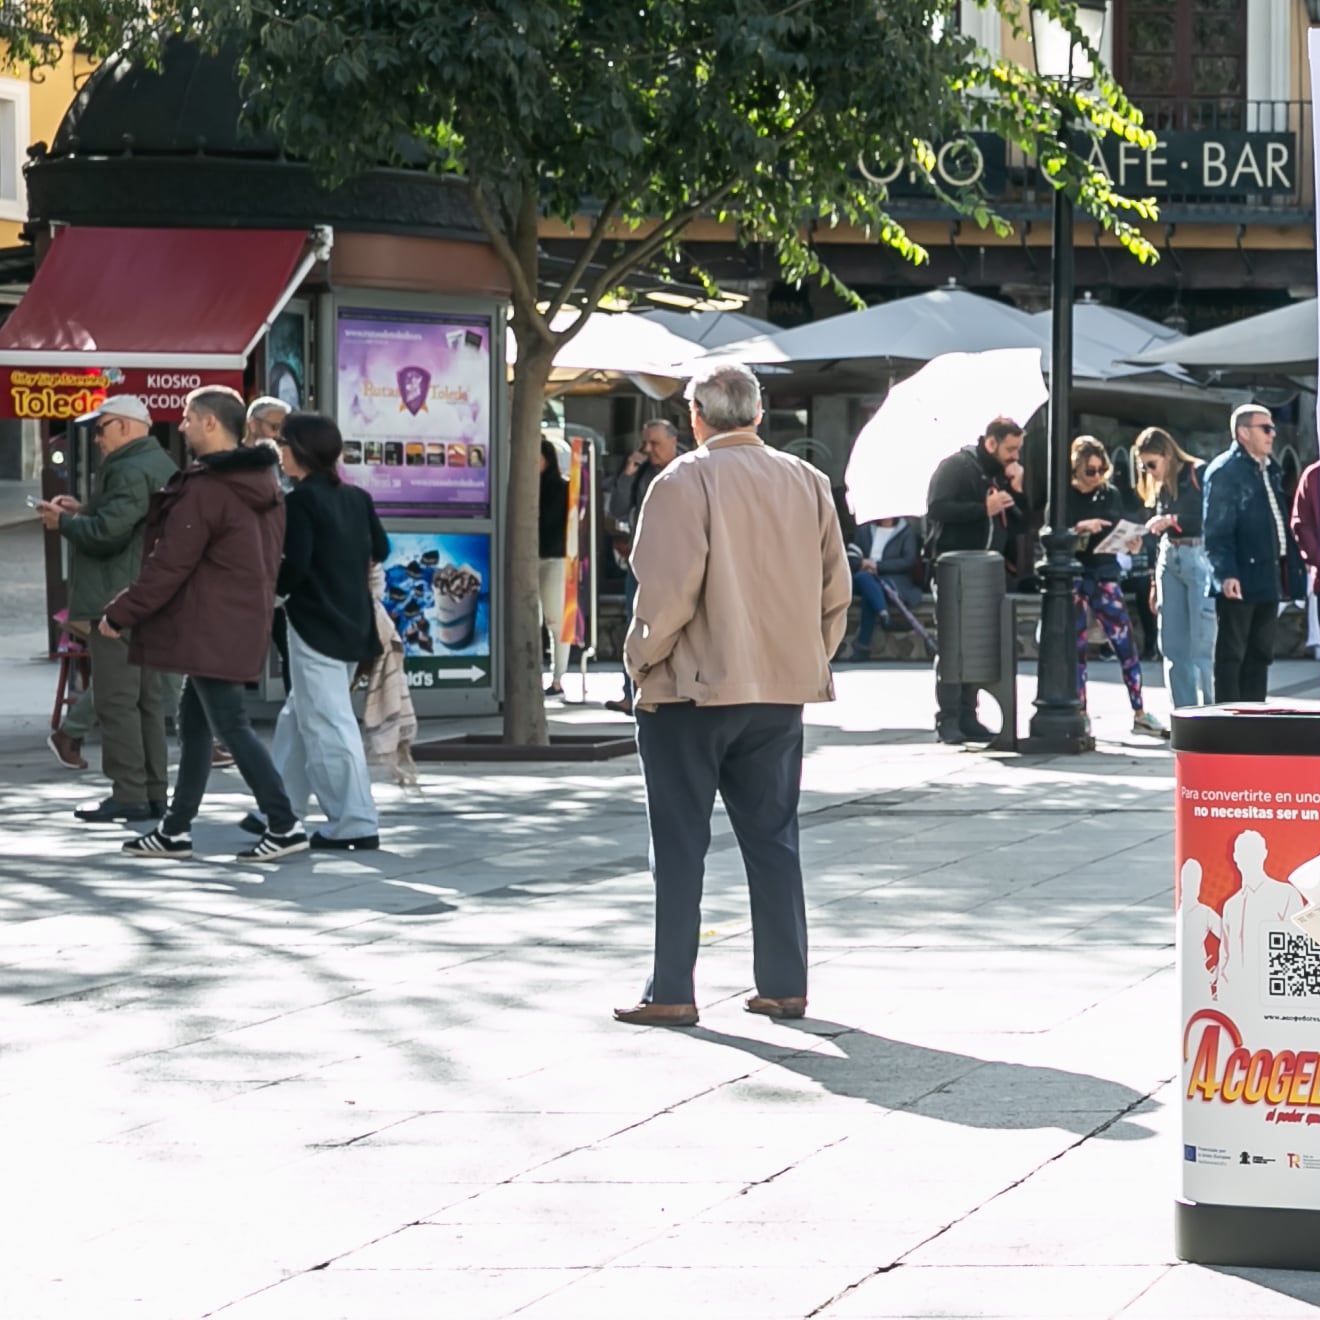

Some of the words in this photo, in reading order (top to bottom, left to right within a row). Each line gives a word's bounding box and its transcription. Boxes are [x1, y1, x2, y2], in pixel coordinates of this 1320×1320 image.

[1203, 141, 1292, 188] BAR
[147, 374, 201, 389] KIOSKO
[1182, 786, 1199, 800] Para
[1201, 789, 1272, 803] convertirte
[1275, 791, 1292, 803] en
[1296, 792, 1320, 804] uno
[1194, 806, 1208, 817] no
[1211, 806, 1273, 819] necesitas
[1277, 808, 1298, 820] ser
[1301, 809, 1319, 820] un
